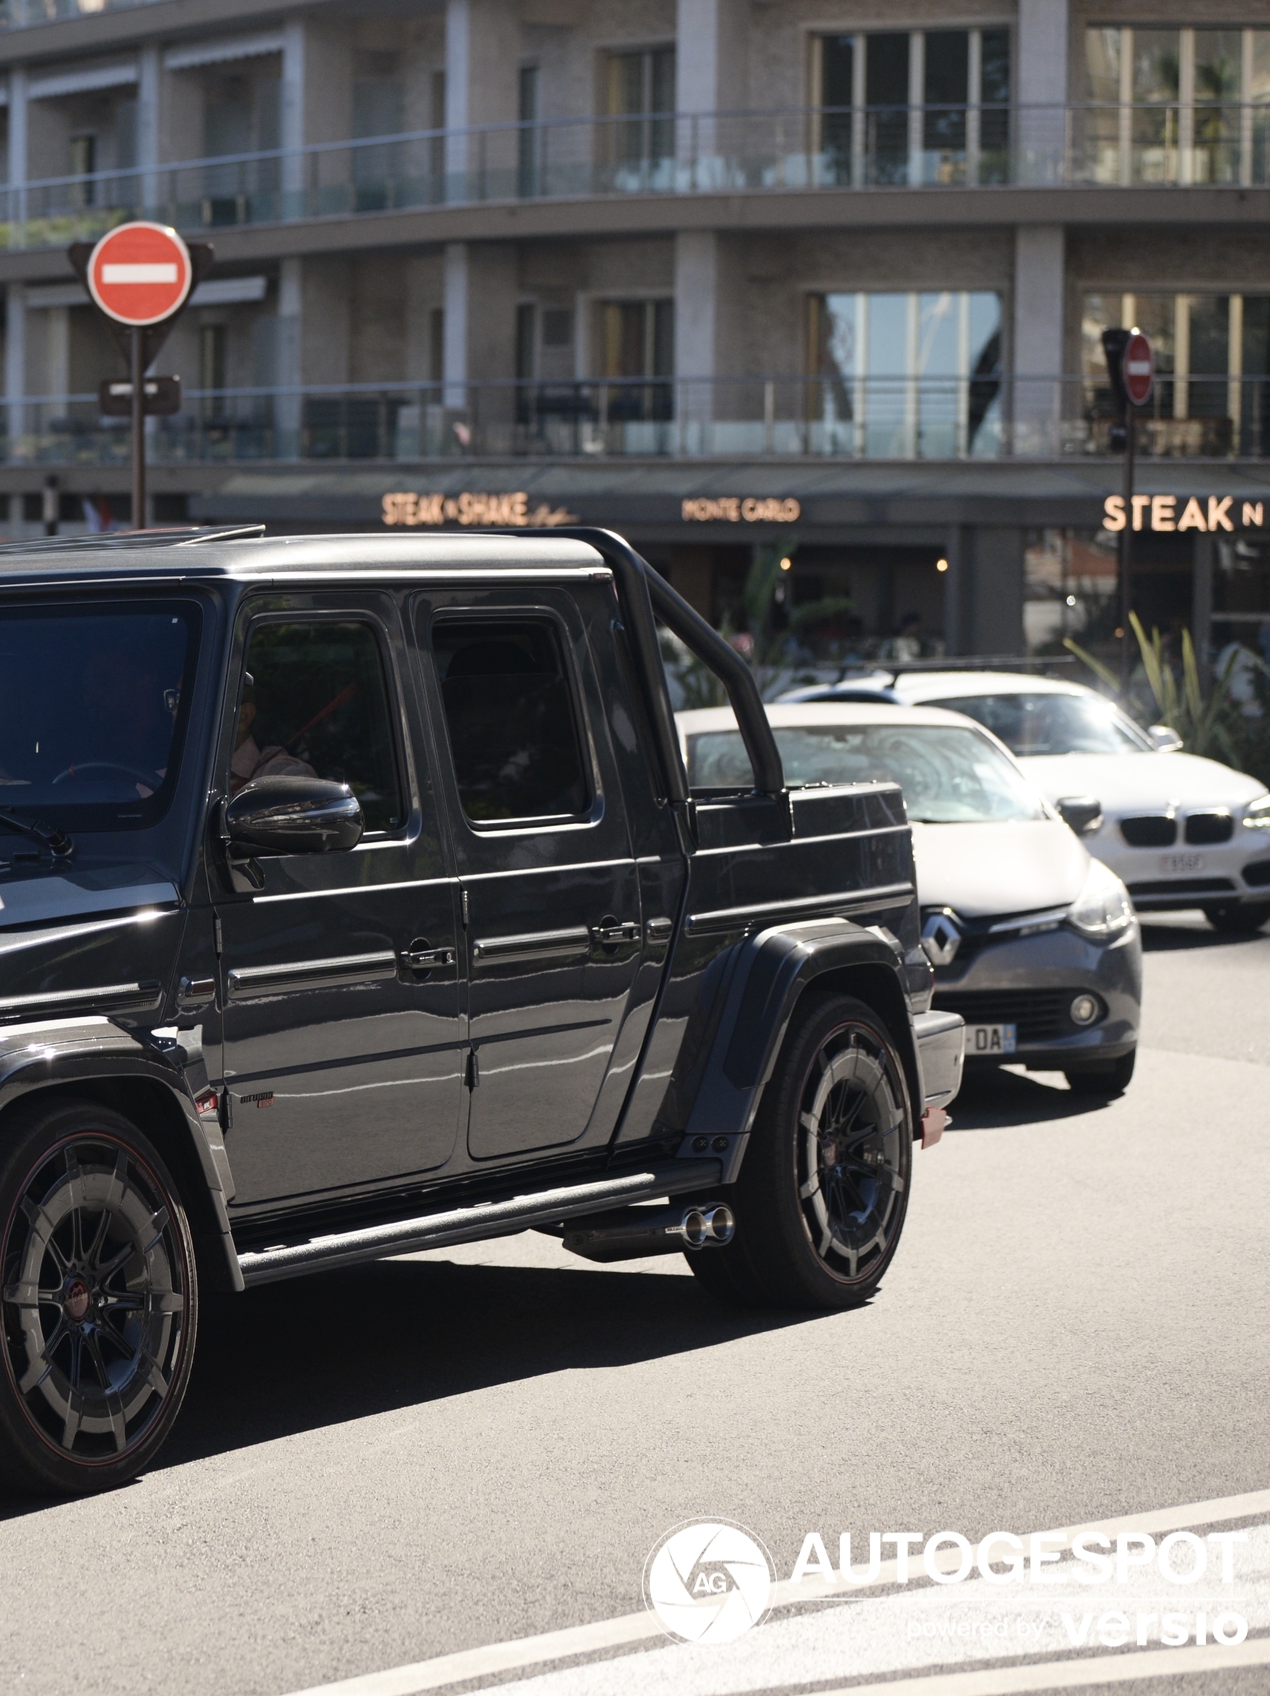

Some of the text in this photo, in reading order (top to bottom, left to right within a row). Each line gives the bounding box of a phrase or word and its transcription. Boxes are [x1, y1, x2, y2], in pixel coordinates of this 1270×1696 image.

[382, 492, 444, 525] STEAK
[458, 492, 529, 526] SHAKE
[681, 497, 801, 522] MONTE CARLO
[1102, 494, 1263, 532] STEAK N
